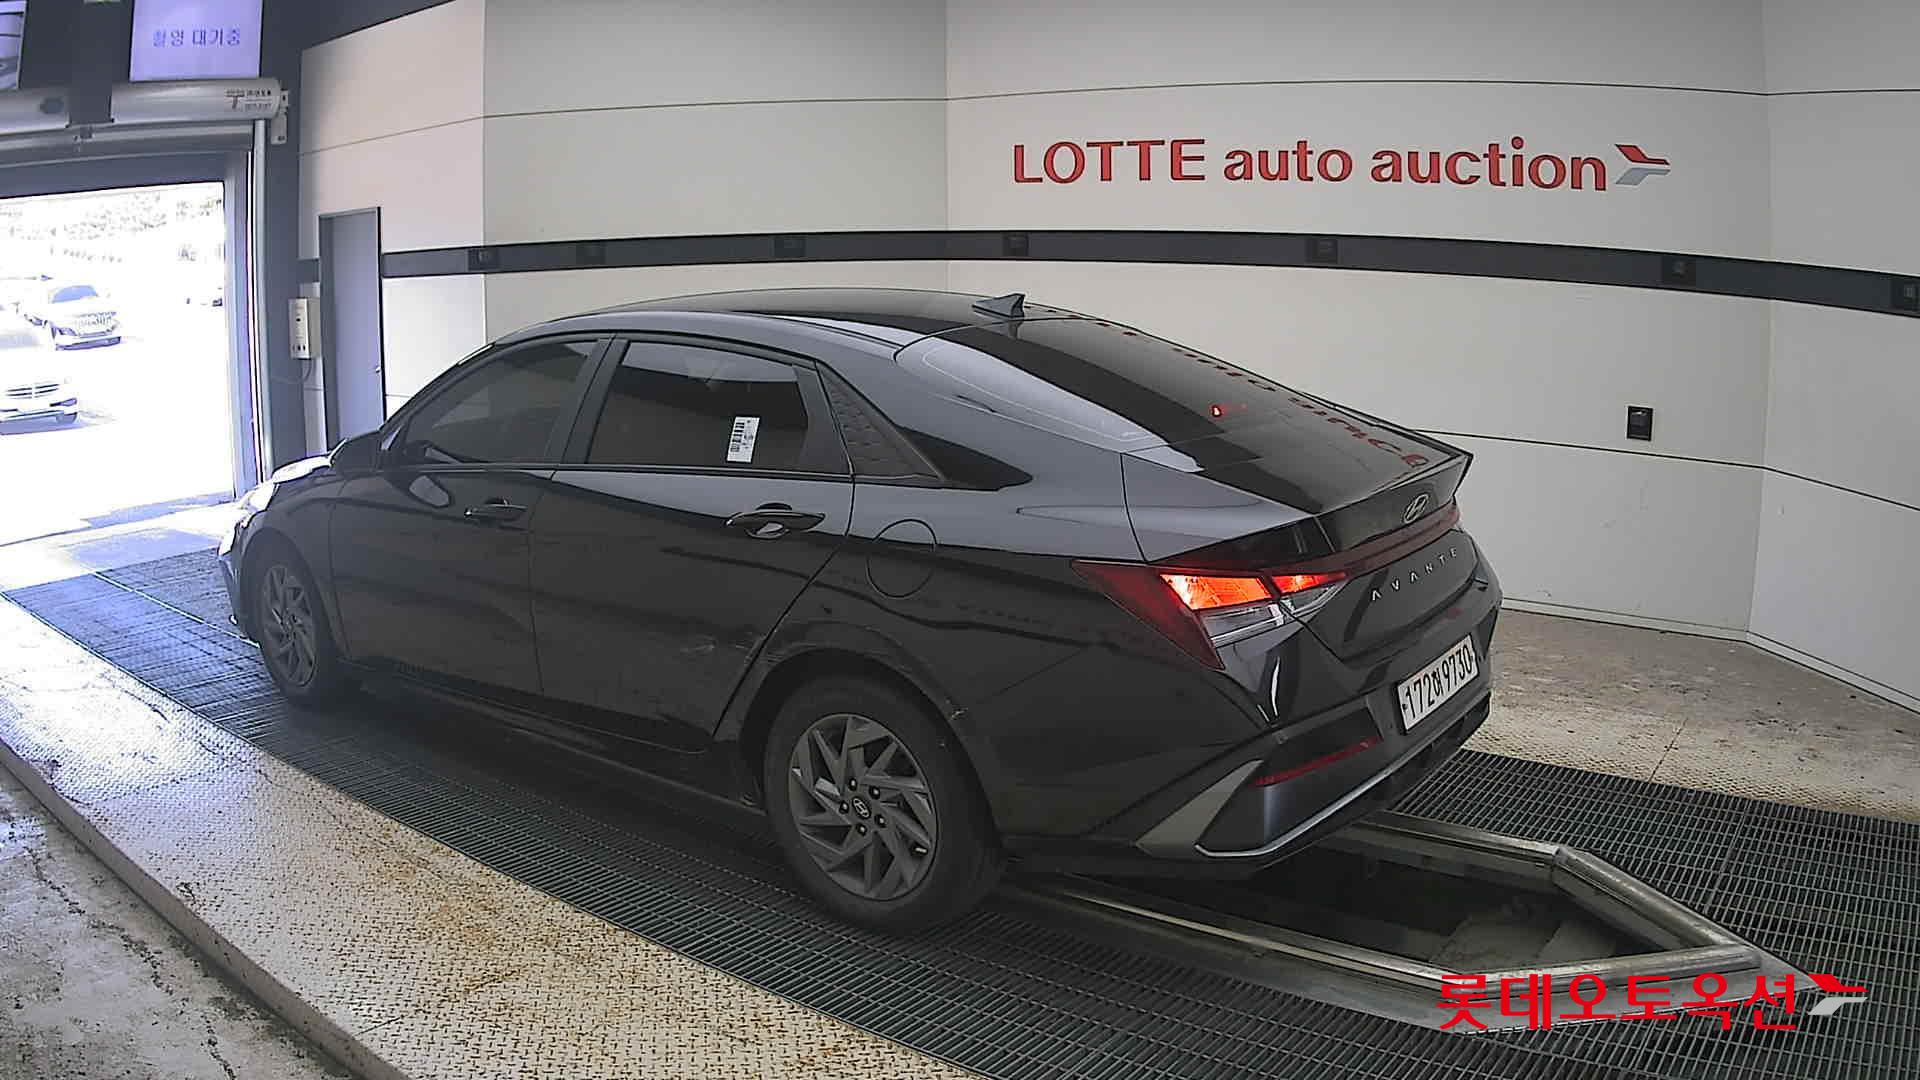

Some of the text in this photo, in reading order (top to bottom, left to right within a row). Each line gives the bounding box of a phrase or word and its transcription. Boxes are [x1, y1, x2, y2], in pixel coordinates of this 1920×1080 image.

[192, 28, 240, 46] 대기중
[1013, 136, 1607, 191] LOTTE auto auction
[1371, 548, 1459, 601] AVANTE
[1404, 643, 1474, 719] 172허9730
